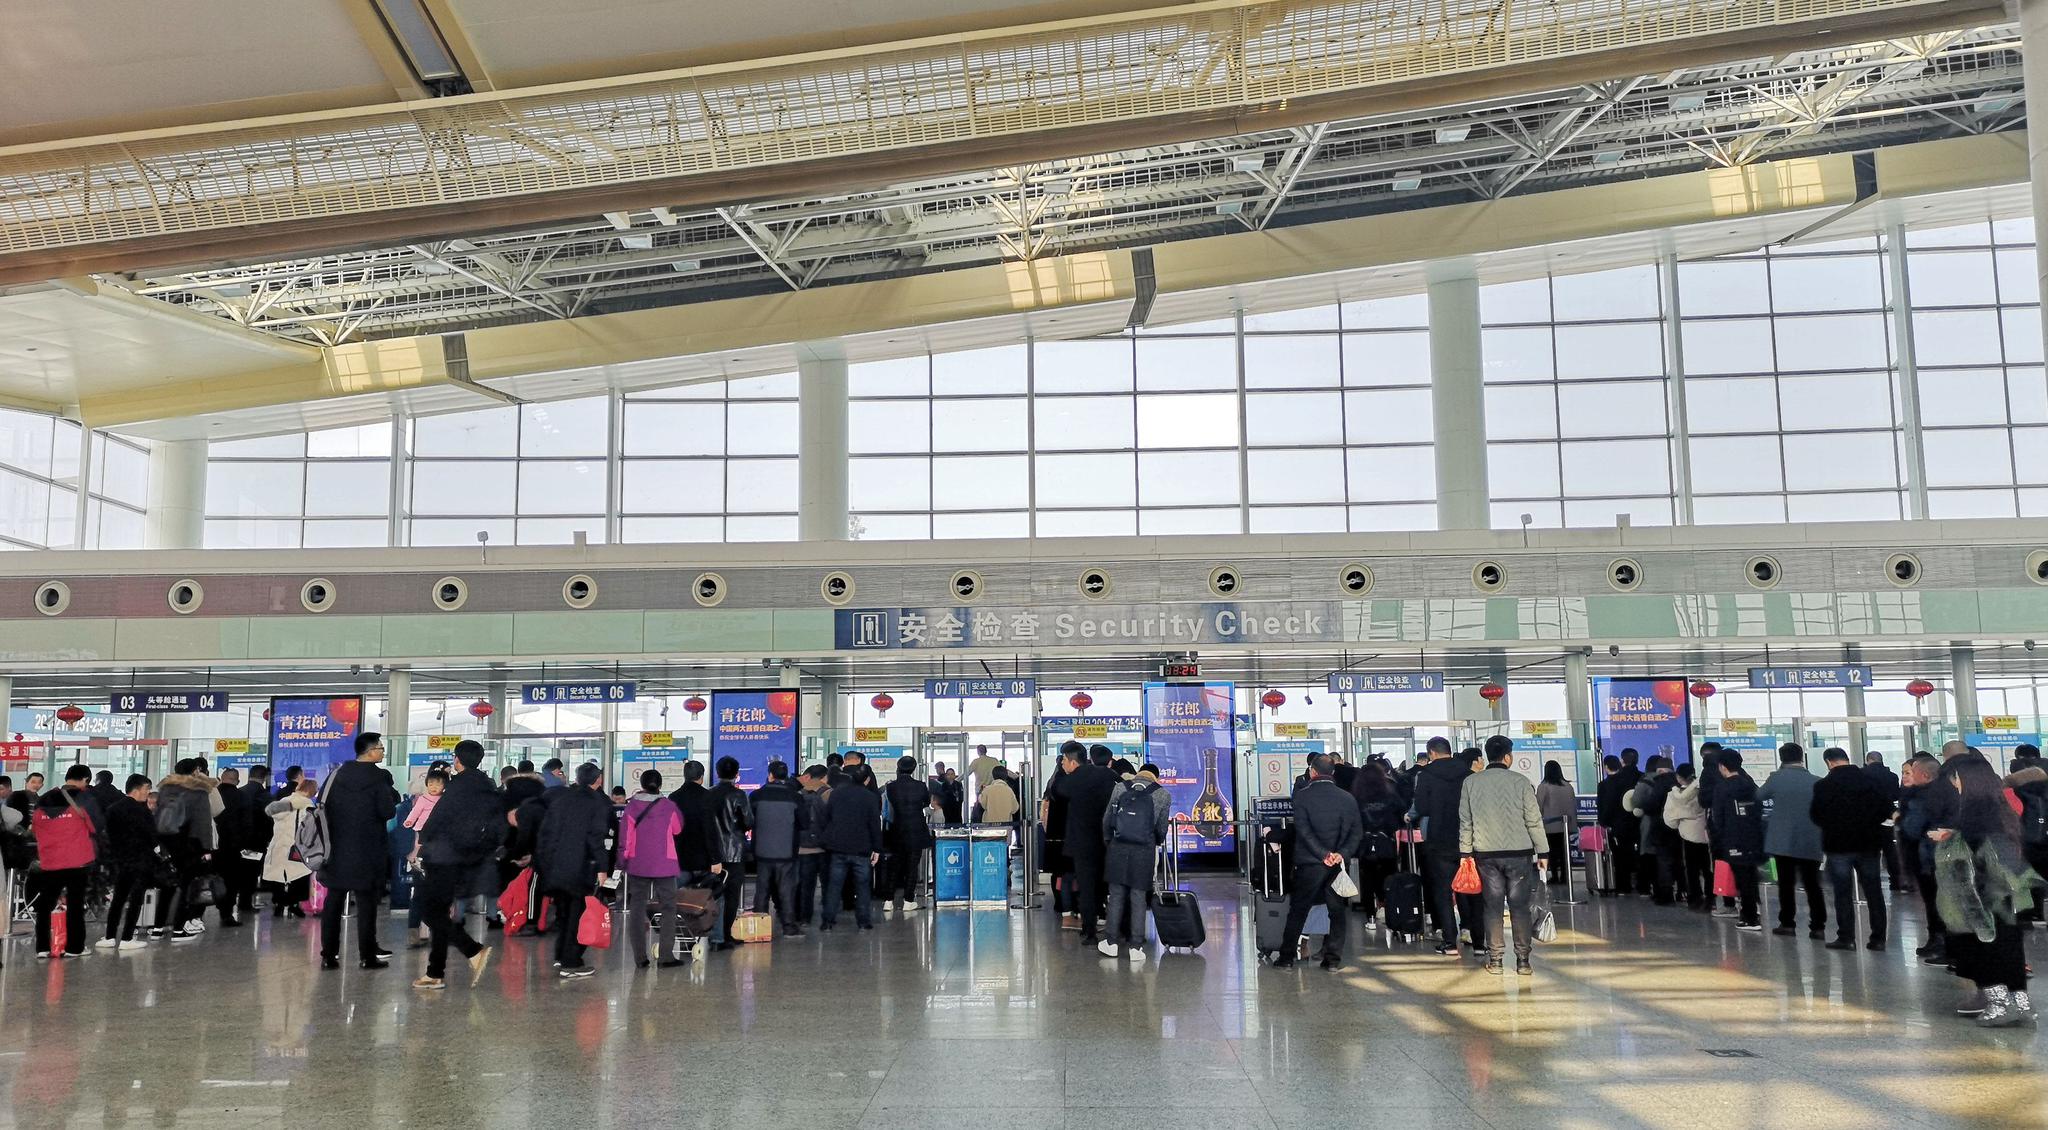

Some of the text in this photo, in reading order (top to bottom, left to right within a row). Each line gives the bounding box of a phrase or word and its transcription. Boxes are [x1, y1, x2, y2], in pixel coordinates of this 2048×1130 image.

[897, 611, 1040, 643] 安全检查
[1055, 609, 1322, 641] Security Check
[1377, 676, 1410, 684] 安全检查
[1763, 670, 1776, 685] 11
[1802, 670, 1836, 679] 安全检查
[1847, 669, 1862, 683] 12
[935, 682, 949, 695] 07
[971, 682, 1003, 690] 安全检查
[1011, 681, 1025, 694] 08
[1338, 677, 1353, 690] 09
[1420, 675, 1433, 689] 10
[531, 687, 547, 701] 05
[569, 686, 601, 695] 安全检查
[609, 686, 624, 699] 06
[120, 696, 135, 710] 03
[147, 696, 187, 704] 头等舱通道
[200, 695, 215, 709] 04
[1605, 696, 1653, 711] 青花郎
[720, 707, 766, 723] 青花郎
[1152, 701, 1200, 717] 青花郎
[279, 713, 327, 730] 青花郎
